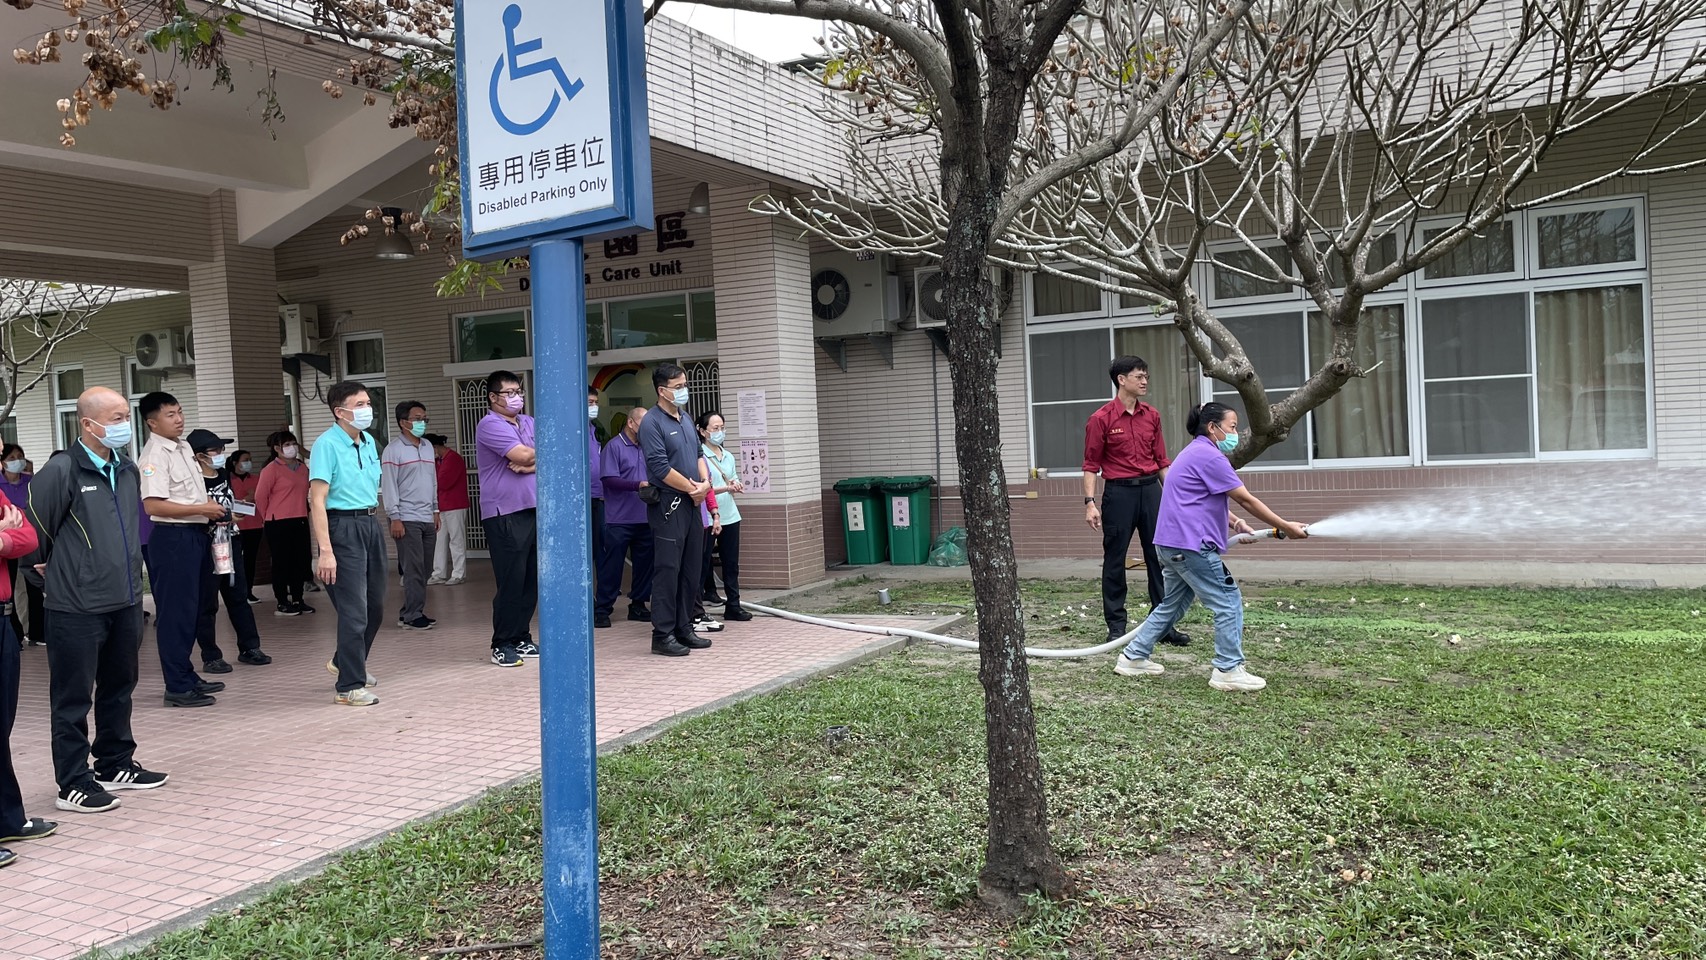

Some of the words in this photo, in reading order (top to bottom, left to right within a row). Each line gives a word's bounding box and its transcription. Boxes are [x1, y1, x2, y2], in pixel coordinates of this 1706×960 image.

[478, 136, 605, 191] 專用停車位
[479, 193, 527, 215] Disabled
[531, 185, 576, 204] Parking
[580, 176, 607, 192] Only
[602, 267, 640, 282] Care
[649, 259, 682, 277] Unit
